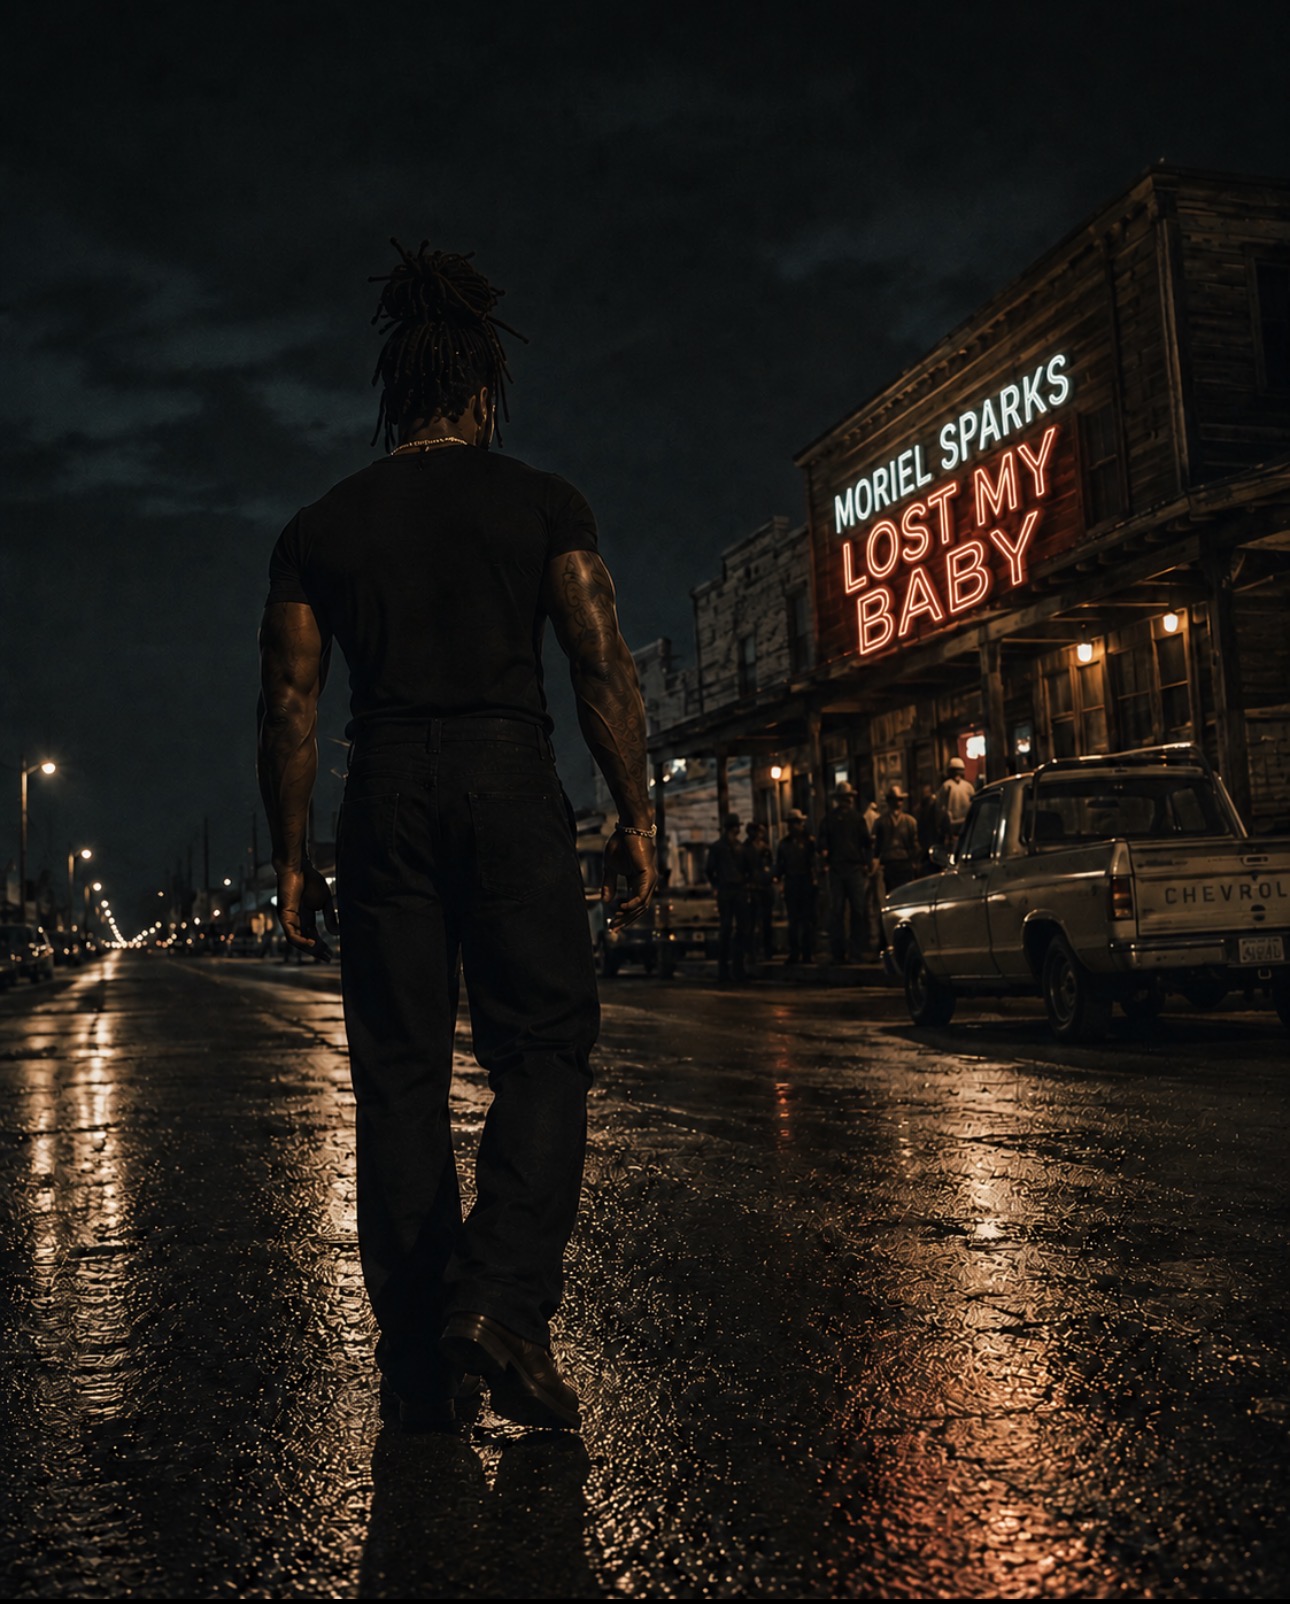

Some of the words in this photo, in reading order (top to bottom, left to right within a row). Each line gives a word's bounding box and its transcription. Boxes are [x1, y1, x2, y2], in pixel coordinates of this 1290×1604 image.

[834, 445, 932, 534] MORIEL
[939, 354, 1070, 470] SPARKS
[843, 482, 957, 594] LOST
[974, 427, 1057, 527] MY
[857, 511, 1039, 656] BABY
[1165, 881, 1288, 905] CHEVROL
